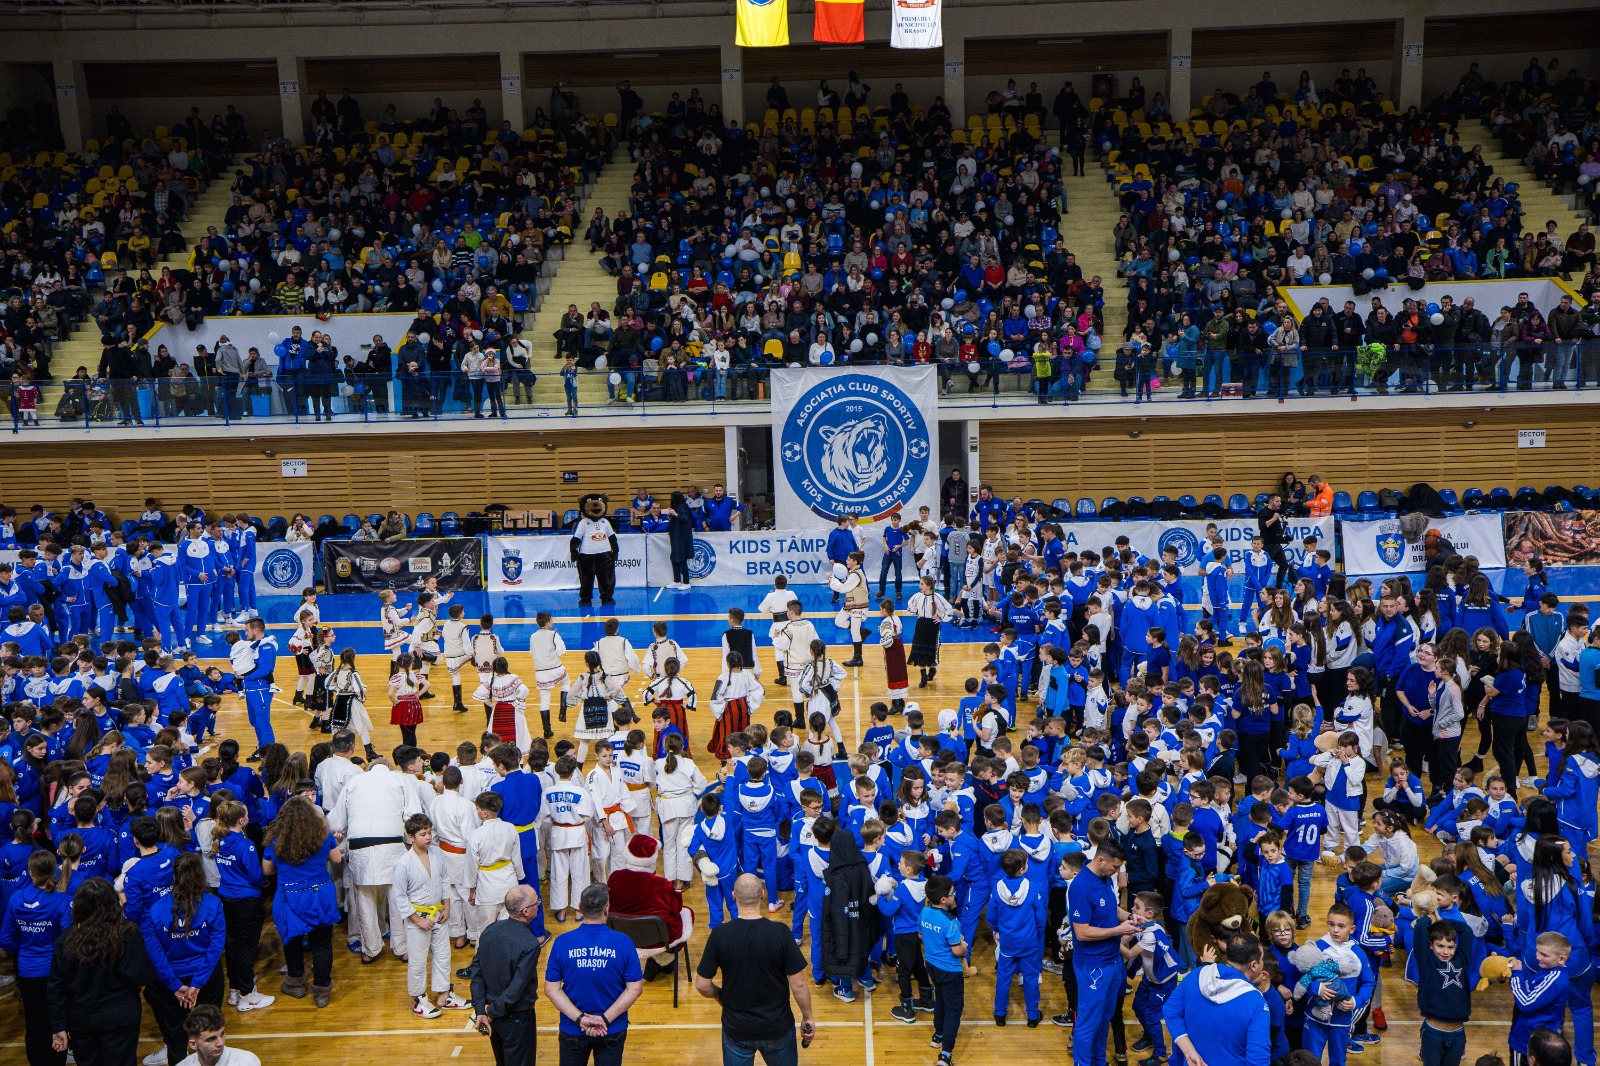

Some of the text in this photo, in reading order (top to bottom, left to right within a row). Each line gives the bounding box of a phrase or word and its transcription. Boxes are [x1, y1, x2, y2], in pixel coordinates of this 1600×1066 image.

[796, 381, 917, 431] ASOCIAȚIA CLUB SPORTIV
[845, 405, 863, 413] 2015
[801, 469, 914, 514] KIDS TÂMPA BRAȘOV
[729, 539, 772, 555] KIDS
[533, 559, 566, 570] PRIMĂRIA
[746, 559, 821, 578] BRAȘOV
[1296, 824, 1318, 845] 10
[568, 945, 617, 959] KIDS TÂMPA
[576, 958, 608, 972] BRAȘOV
